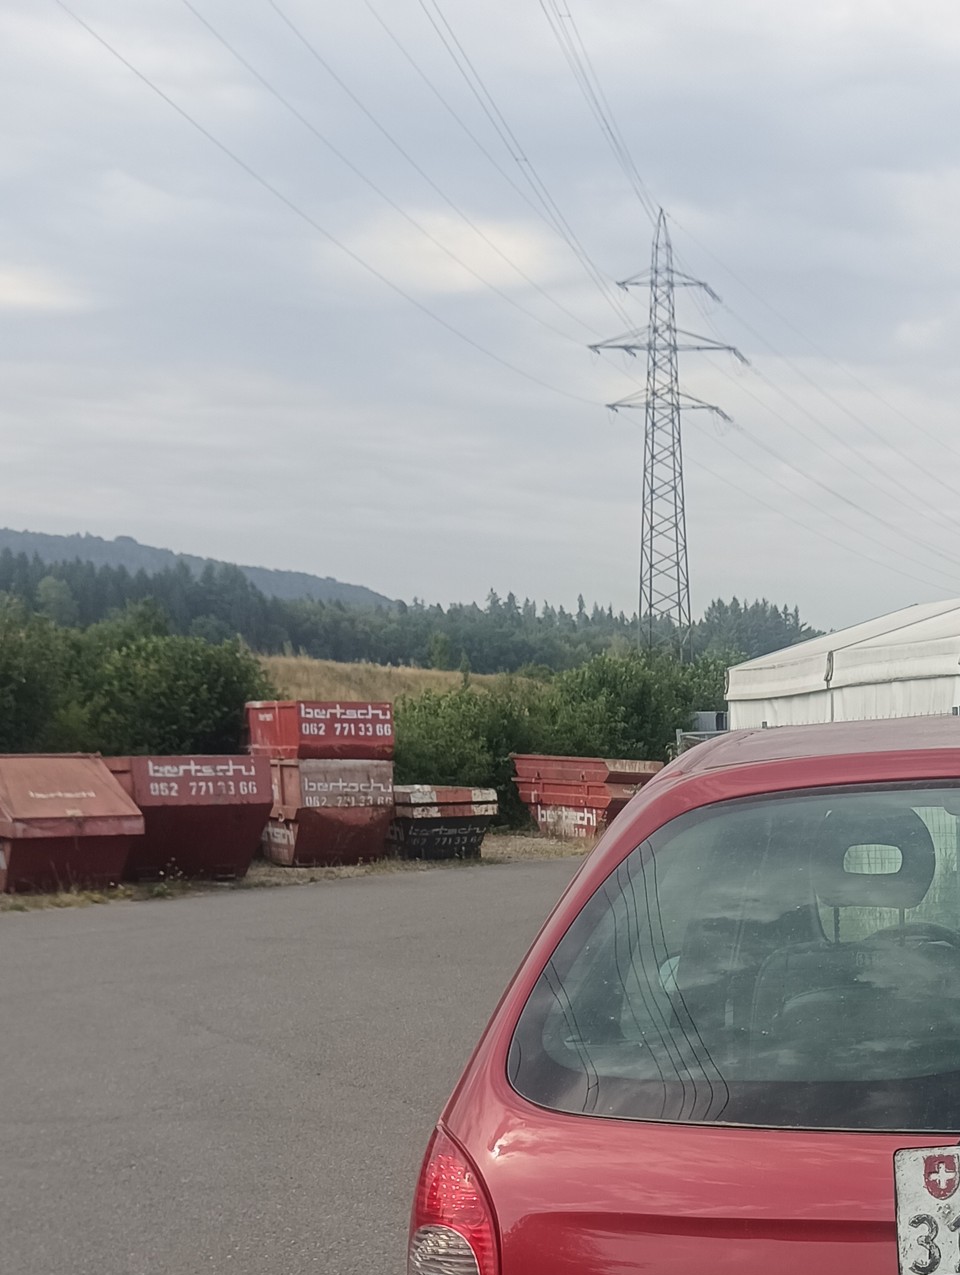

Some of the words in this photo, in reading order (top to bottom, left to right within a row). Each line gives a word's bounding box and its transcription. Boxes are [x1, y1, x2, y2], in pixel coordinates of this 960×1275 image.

[301, 703, 391, 719] bertschi
[302, 723, 326, 735] 062
[334, 723, 355, 736] 771
[148, 759, 256, 777] bertschi
[189, 782, 214, 796] 771
[304, 777, 393, 793] bertschi
